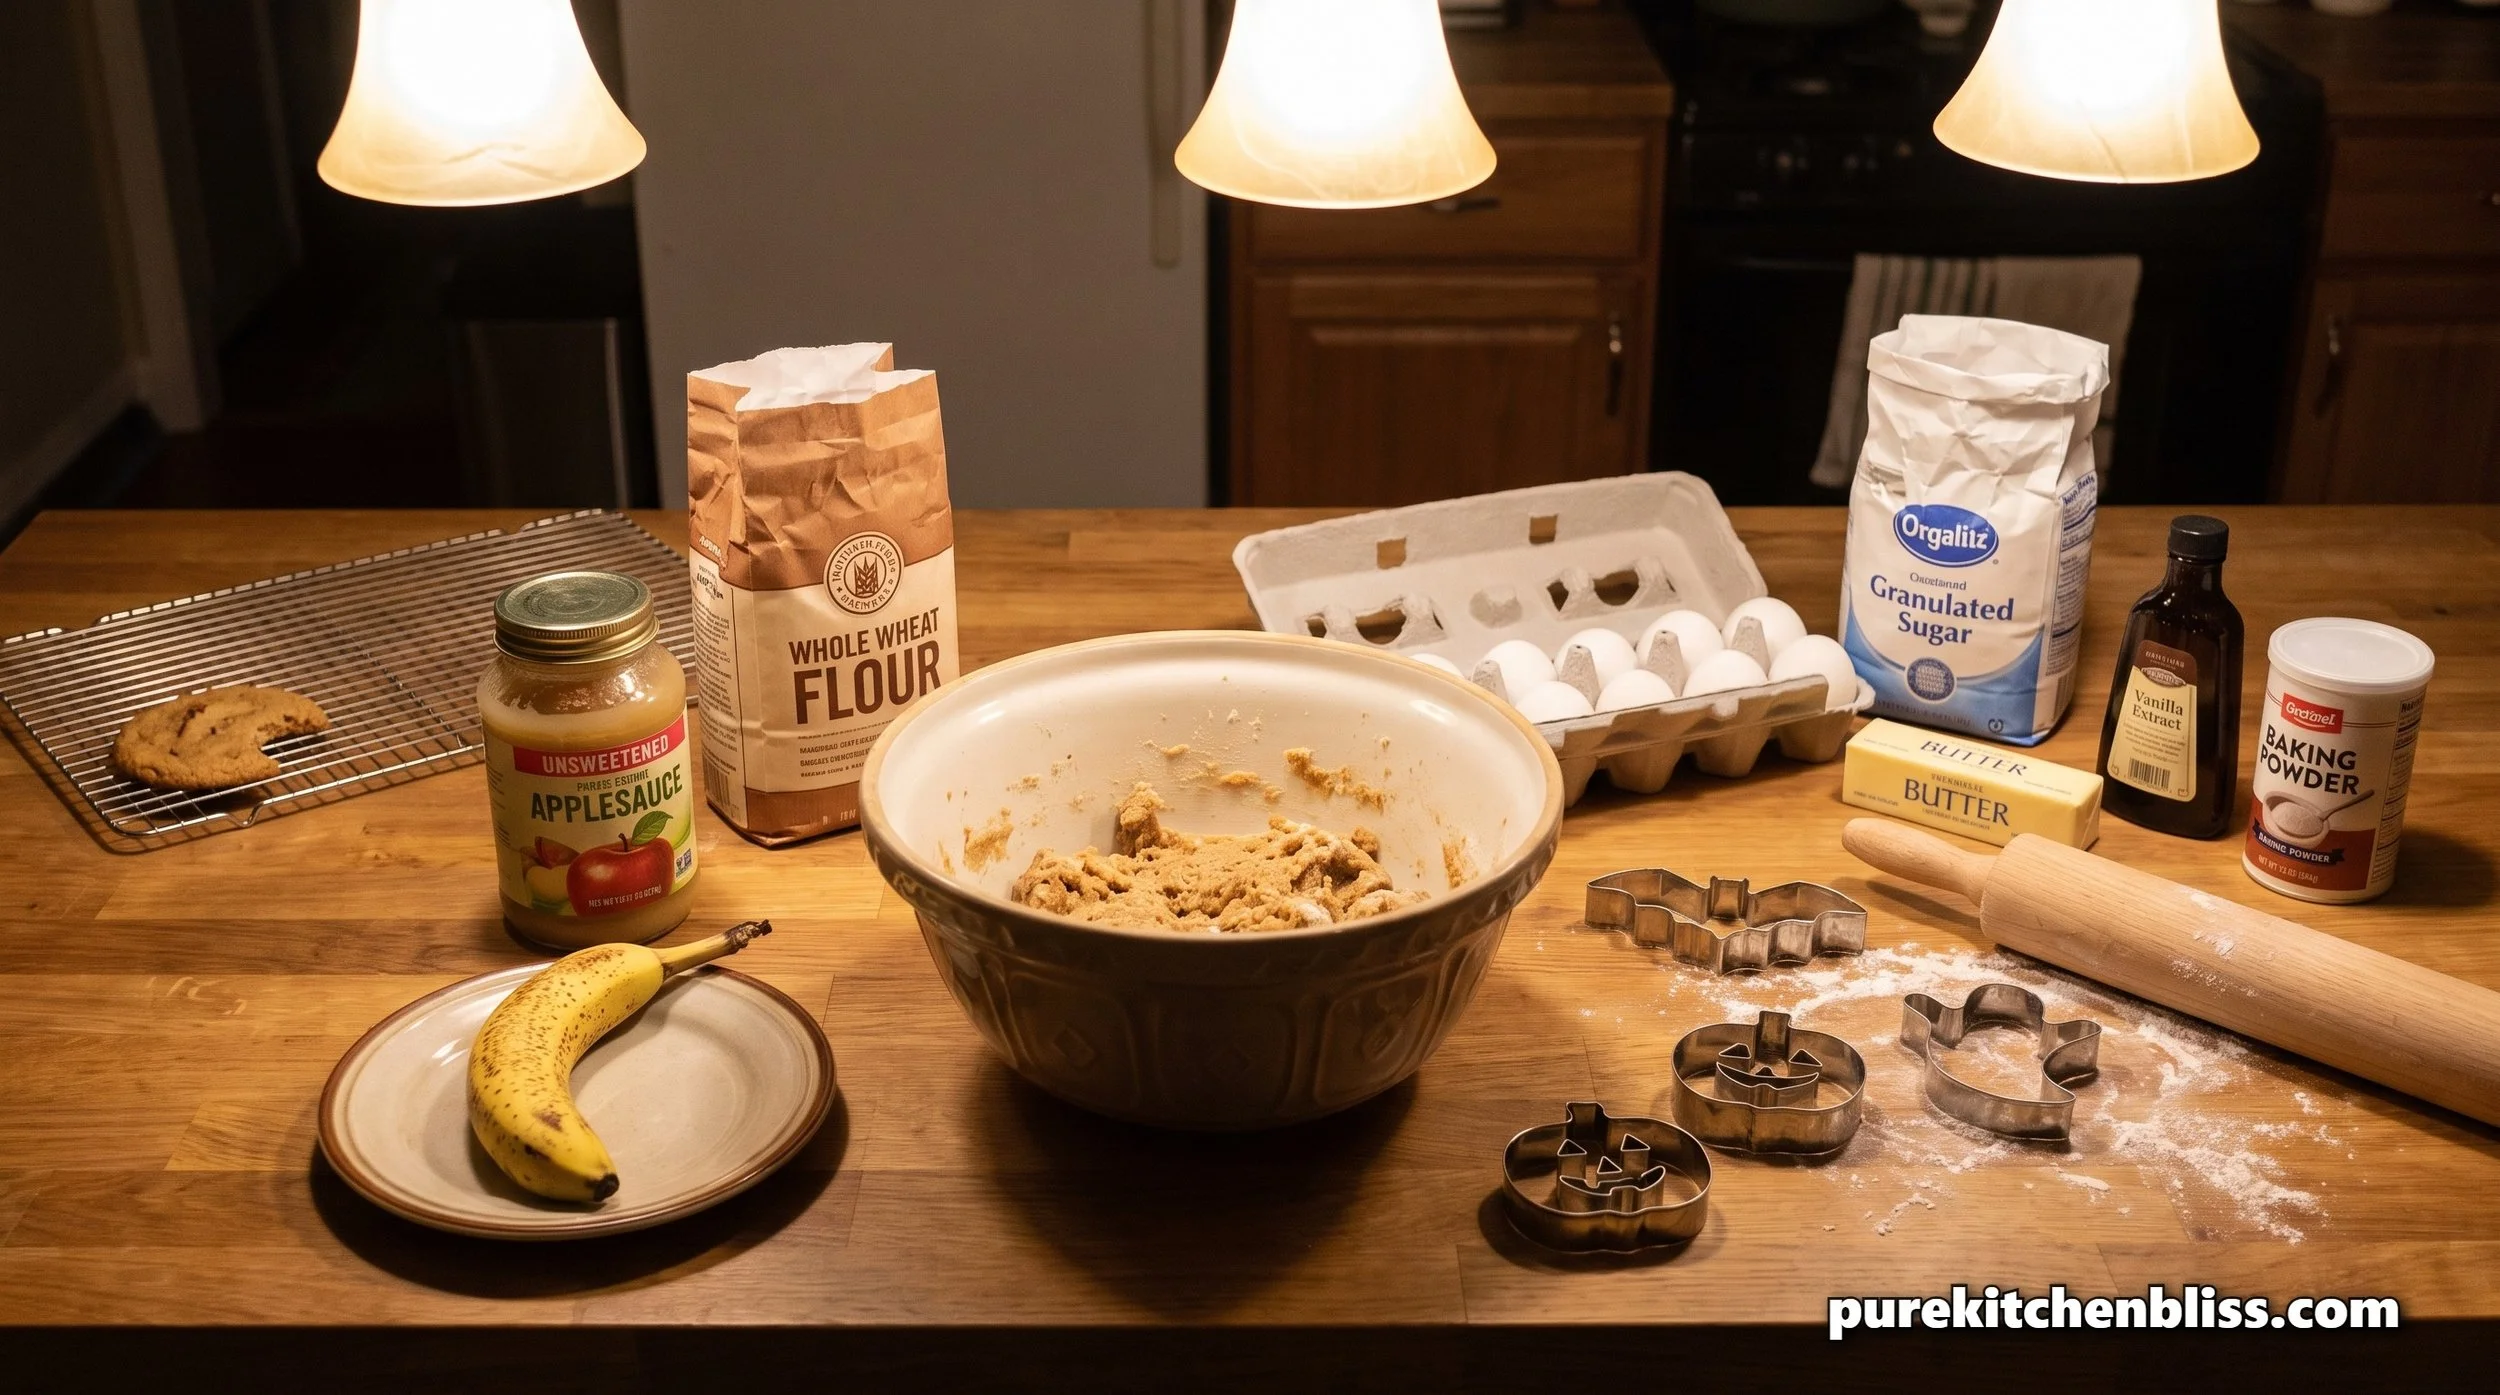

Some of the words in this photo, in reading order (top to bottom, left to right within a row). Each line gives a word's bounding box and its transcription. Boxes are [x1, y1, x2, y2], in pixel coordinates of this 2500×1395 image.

[1870, 575, 2014, 621] Granulated
[788, 630, 870, 665] WHOLE
[875, 607, 939, 650] WHEAT
[1898, 612, 1972, 646] Sugar
[793, 640, 941, 725] FLOUR
[2135, 689, 2183, 716] Vanilla
[2132, 704, 2181, 730] Extract
[542, 734, 669, 775] UNSWEETENED
[1920, 741, 2027, 776] BUTTER
[2260, 744, 2360, 795] POWDER
[2266, 724, 2357, 771] BAKING
[531, 763, 683, 823] APPLESAUCE
[1904, 778, 2009, 826] BUTTER
[2289, 847, 2330, 863] POWDER
